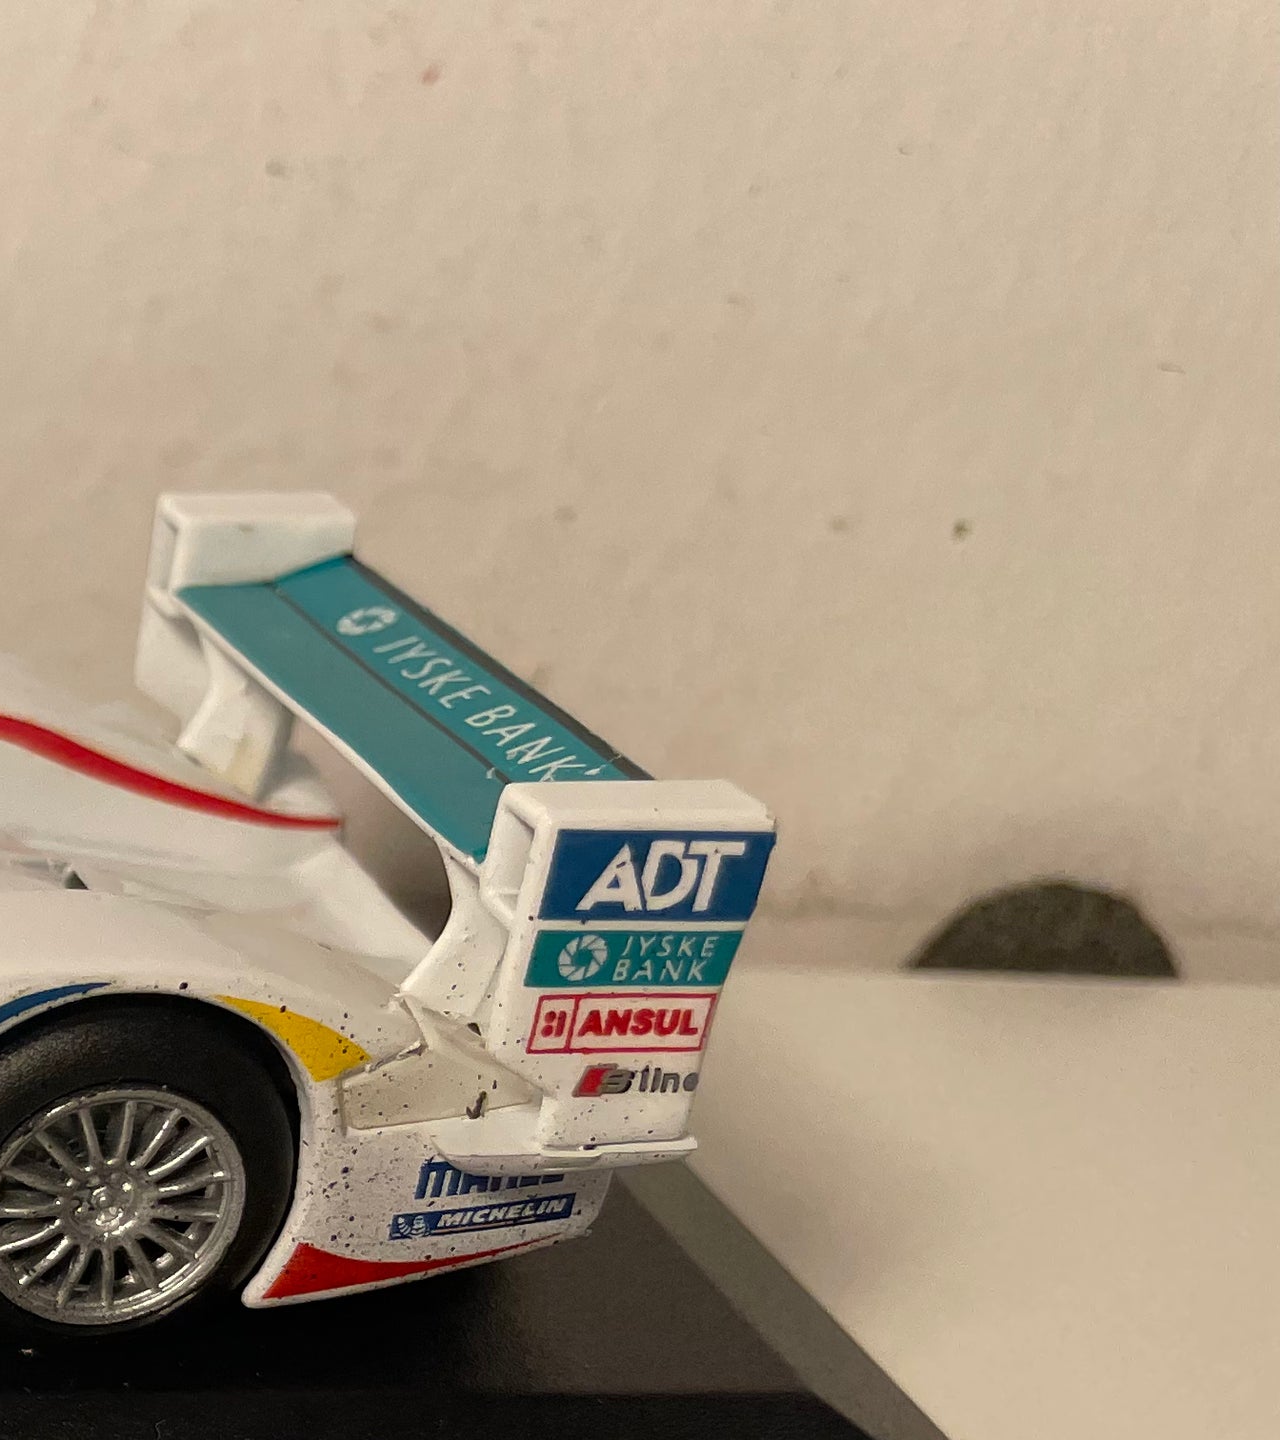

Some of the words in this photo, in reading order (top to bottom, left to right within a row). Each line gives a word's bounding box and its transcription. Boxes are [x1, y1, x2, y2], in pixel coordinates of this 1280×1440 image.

[464, 704, 587, 782] BANK
[576, 840, 747, 913] ADT
[621, 935, 720, 957] JYSKE
[612, 959, 708, 982] BANK
[577, 1008, 699, 1037] ANSUL
[437, 1198, 568, 1228] MICHELIN
